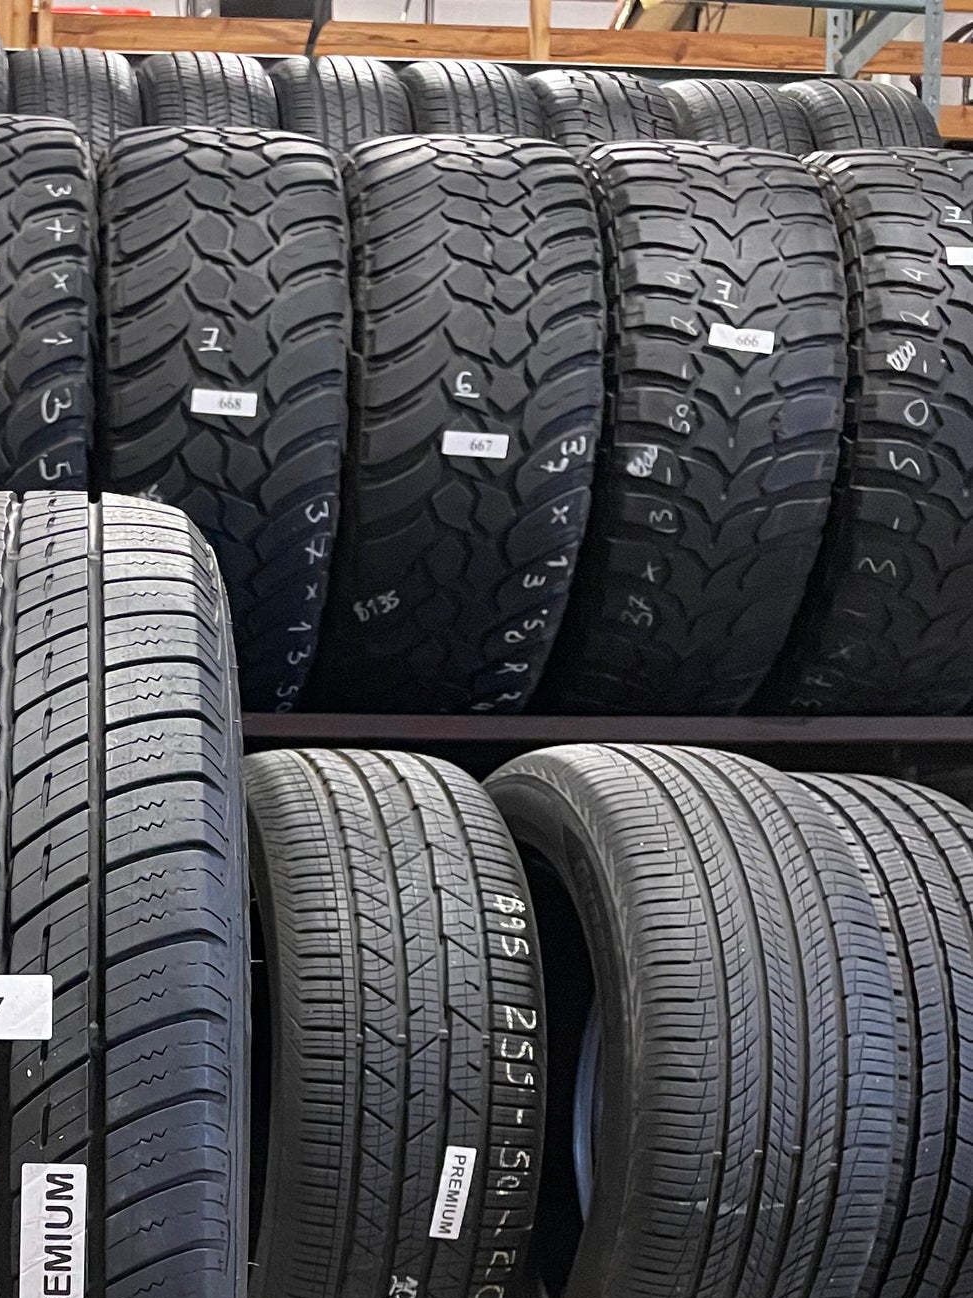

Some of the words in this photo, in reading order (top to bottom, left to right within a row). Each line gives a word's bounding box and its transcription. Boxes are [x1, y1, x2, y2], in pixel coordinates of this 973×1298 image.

[735, 334, 760, 347] 666
[217, 396, 242, 411] 668
[468, 439, 494, 453] 667
[437, 1153, 468, 1237] PREMIUM
